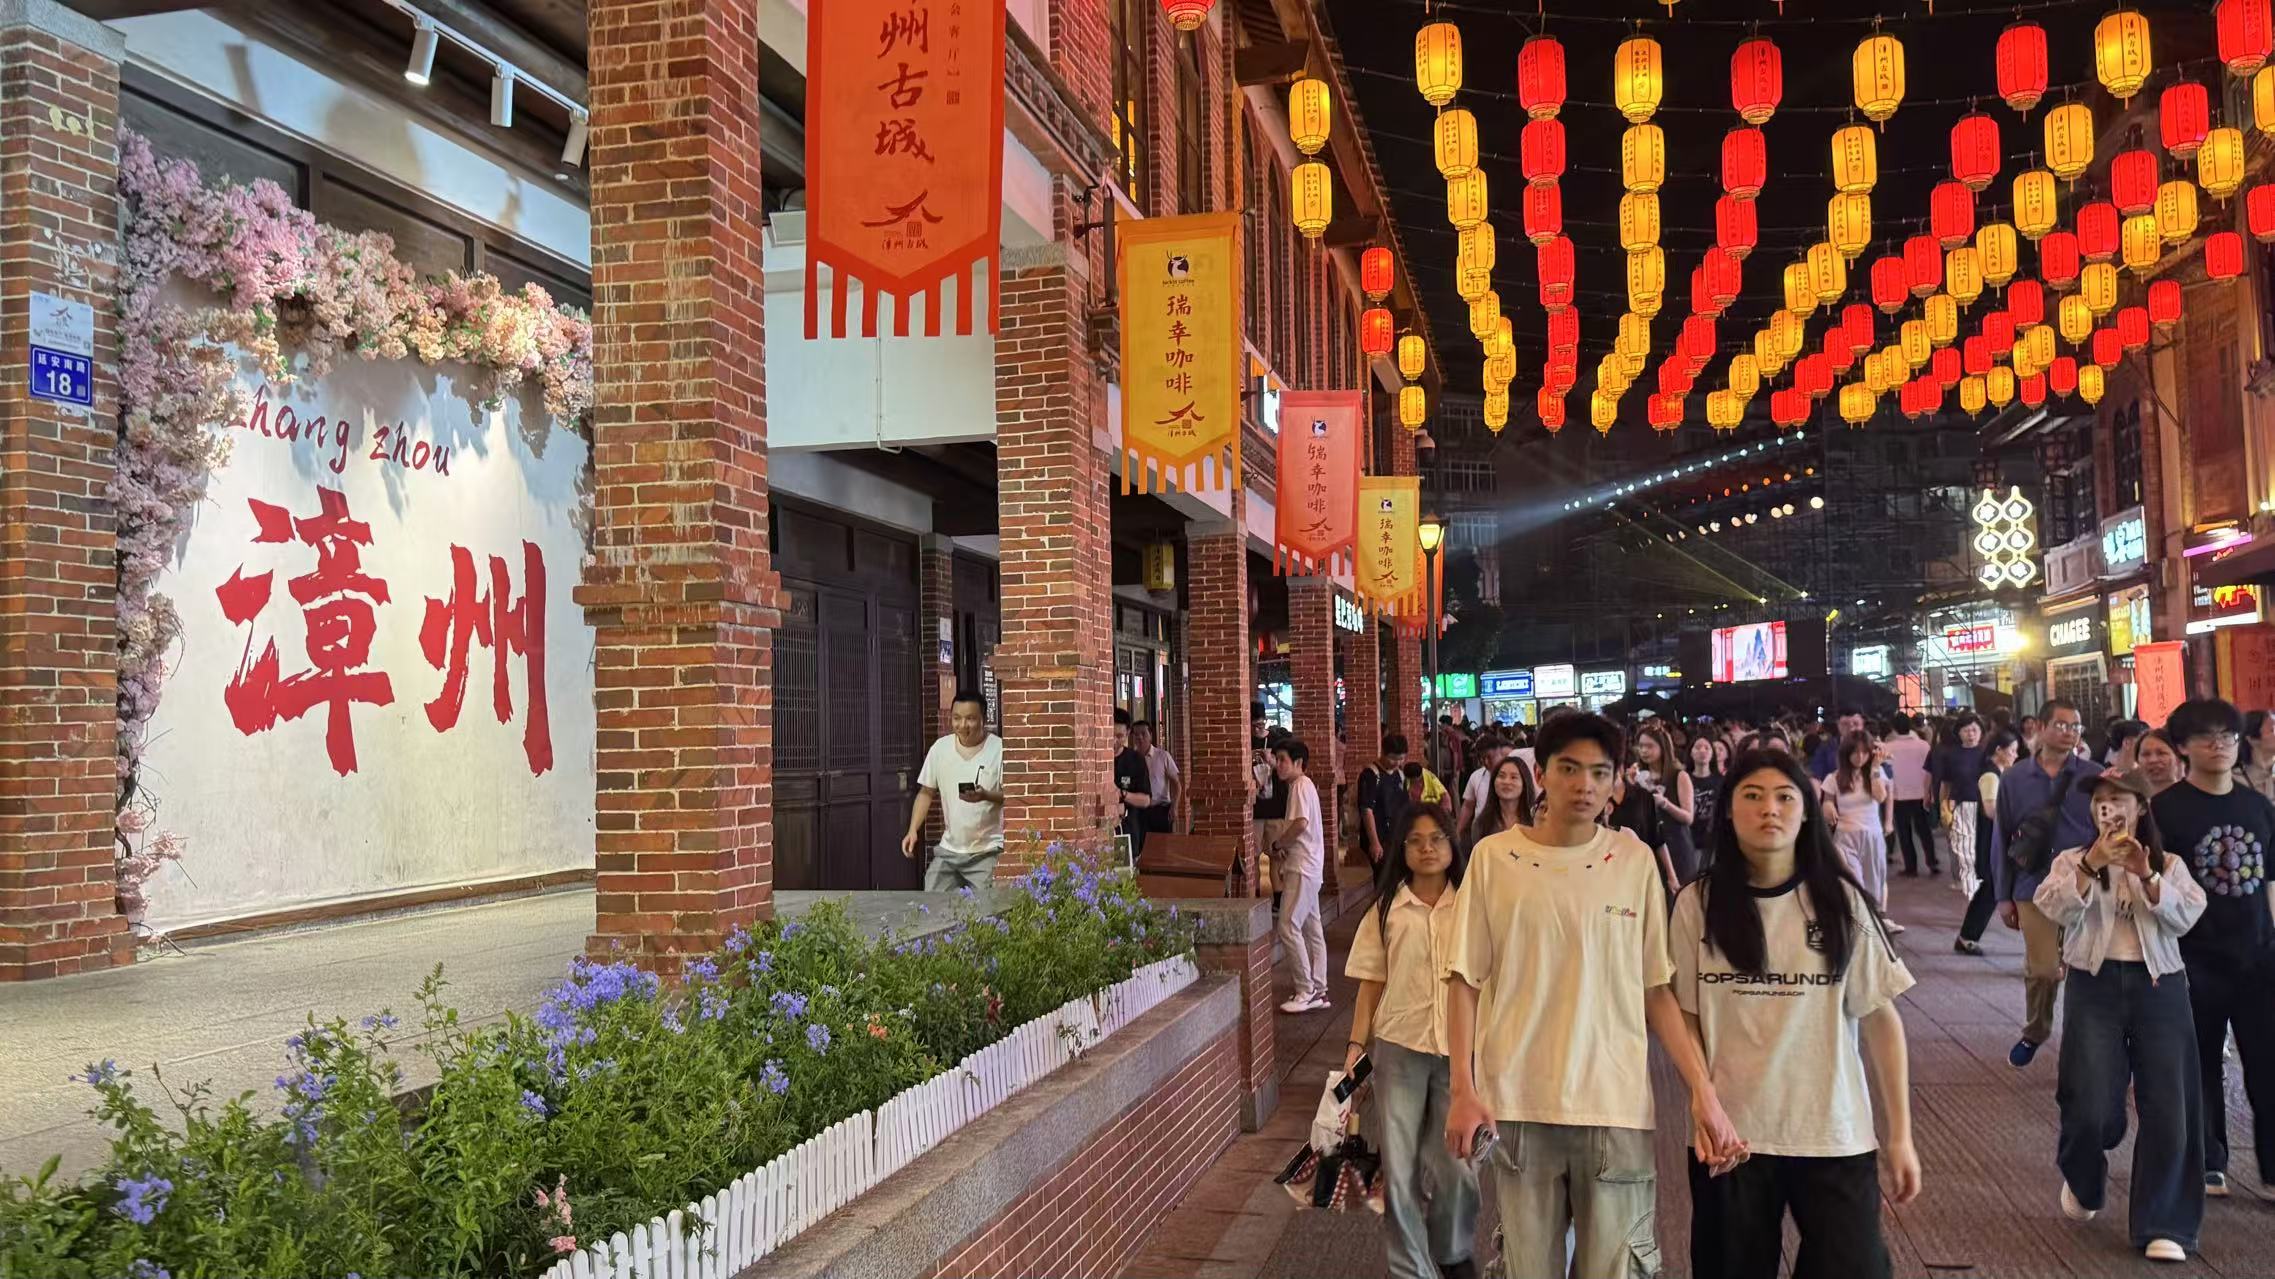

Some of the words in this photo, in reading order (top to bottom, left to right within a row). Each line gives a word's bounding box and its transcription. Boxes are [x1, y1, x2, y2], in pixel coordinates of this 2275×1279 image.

[875, 0, 934, 163] 州古城
[38, 353, 86, 375] 延安南路
[1165, 295, 1194, 396] 瑞幸咖啡
[46, 370, 72, 396] 18
[230, 384, 349, 474] hang
[369, 420, 450, 477] zhou
[1307, 443, 1327, 511] 瑞幸咖啡
[1378, 517, 1393, 569] 瑞幸咖啡
[216, 484, 554, 778] 漳州
[2050, 617, 2091, 647] CHAGEE
